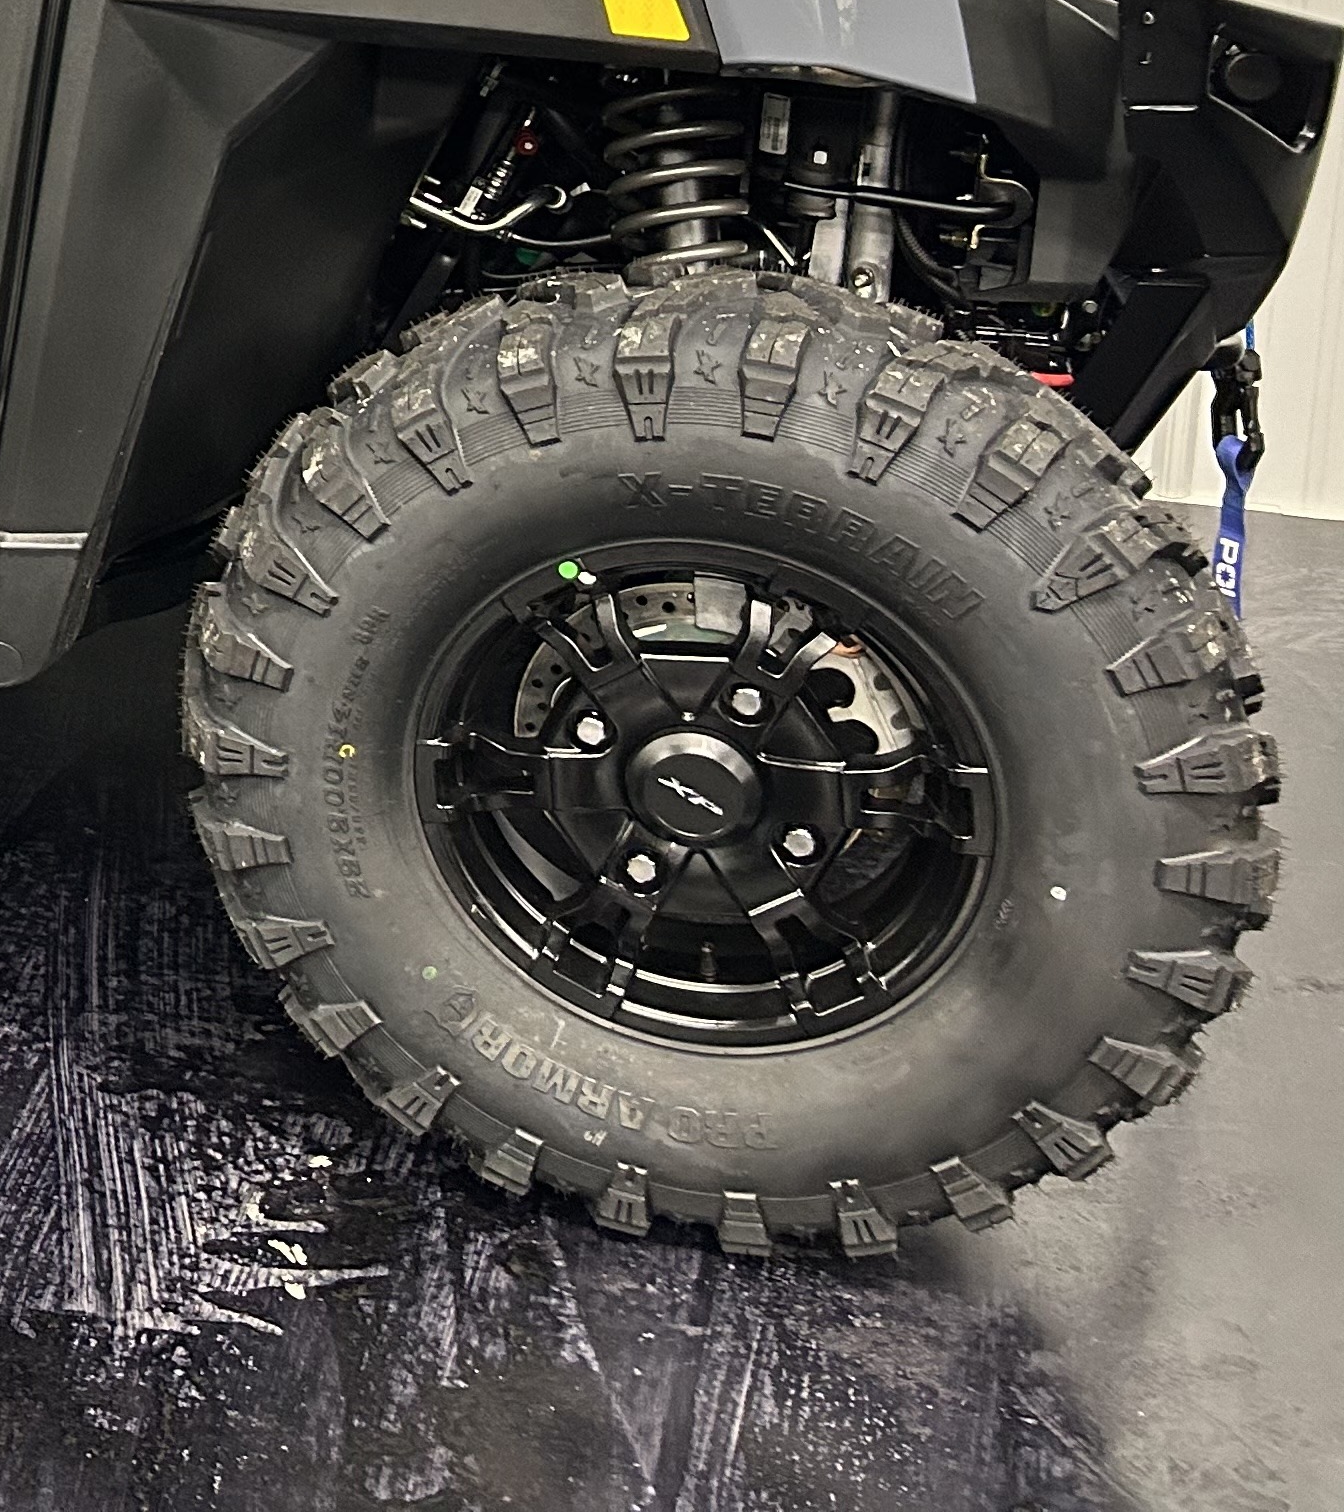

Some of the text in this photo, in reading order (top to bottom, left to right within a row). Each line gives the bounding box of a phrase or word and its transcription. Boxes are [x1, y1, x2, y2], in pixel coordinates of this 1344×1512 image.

[617, 470, 987, 620] X-TERRAIN
[656, 776, 724, 816] XP
[470, 1011, 784, 1151] PRO ARMOR
